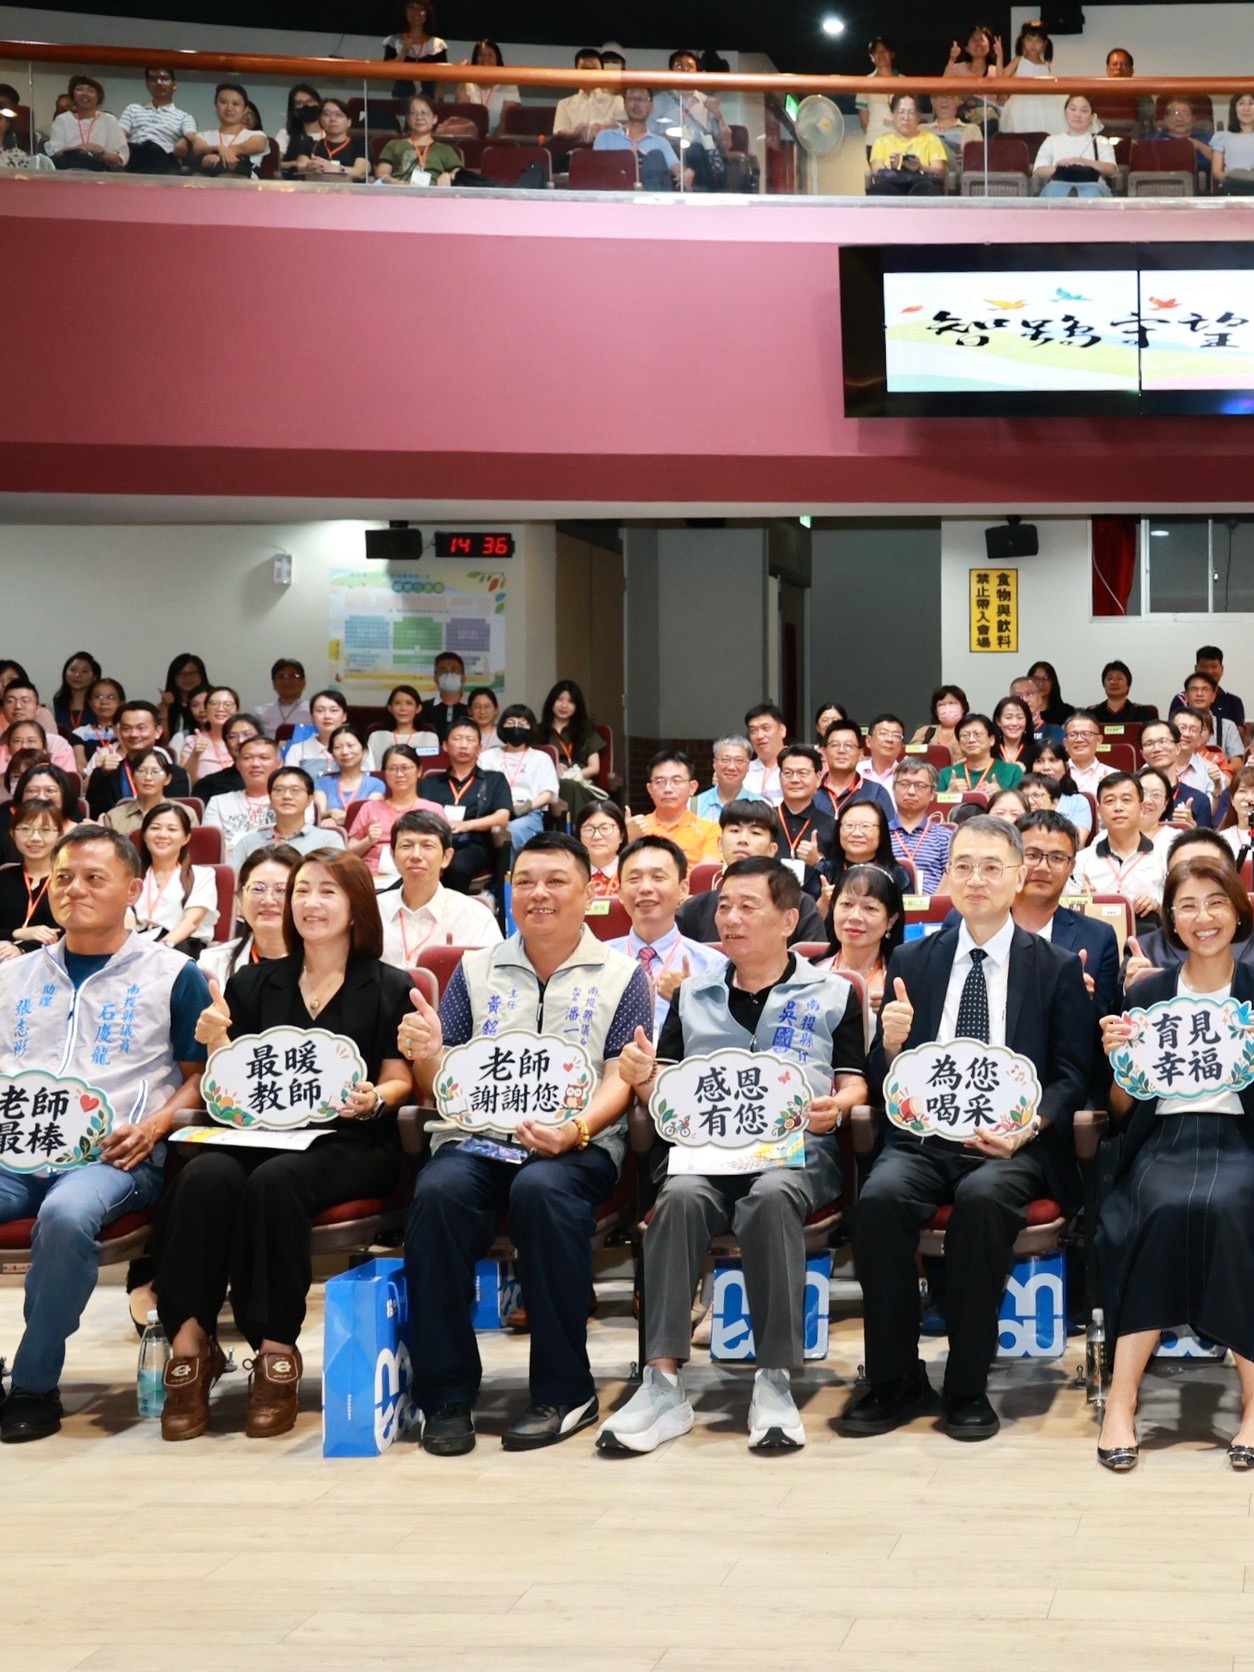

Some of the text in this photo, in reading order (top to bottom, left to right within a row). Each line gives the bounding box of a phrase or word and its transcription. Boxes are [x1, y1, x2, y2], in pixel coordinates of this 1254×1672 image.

[450, 536, 508, 555] 14 36
[976, 573, 991, 648] 禁止帶入會場
[996, 572, 1011, 648] 食物與飲料
[40, 984, 56, 1007] 助理
[91, 1003, 116, 1066] 石慶龍
[119, 984, 140, 1054] 南投縣議員
[1152, 1011, 1220, 1050] 育見
[246, 1040, 323, 1079] 最暖
[478, 1047, 550, 1081] 老師
[928, 1055, 1000, 1091] 為您
[1152, 1048, 1223, 1086] 幸福
[0, 1085, 70, 1120] 老師
[247, 1078, 322, 1115] 教師
[469, 1083, 560, 1114] 謝謝您
[694, 1067, 769, 1102] 感恩
[698, 1103, 768, 1137] 有您
[925, 1090, 998, 1127] 喝采
[0, 1121, 67, 1158] 最棒
